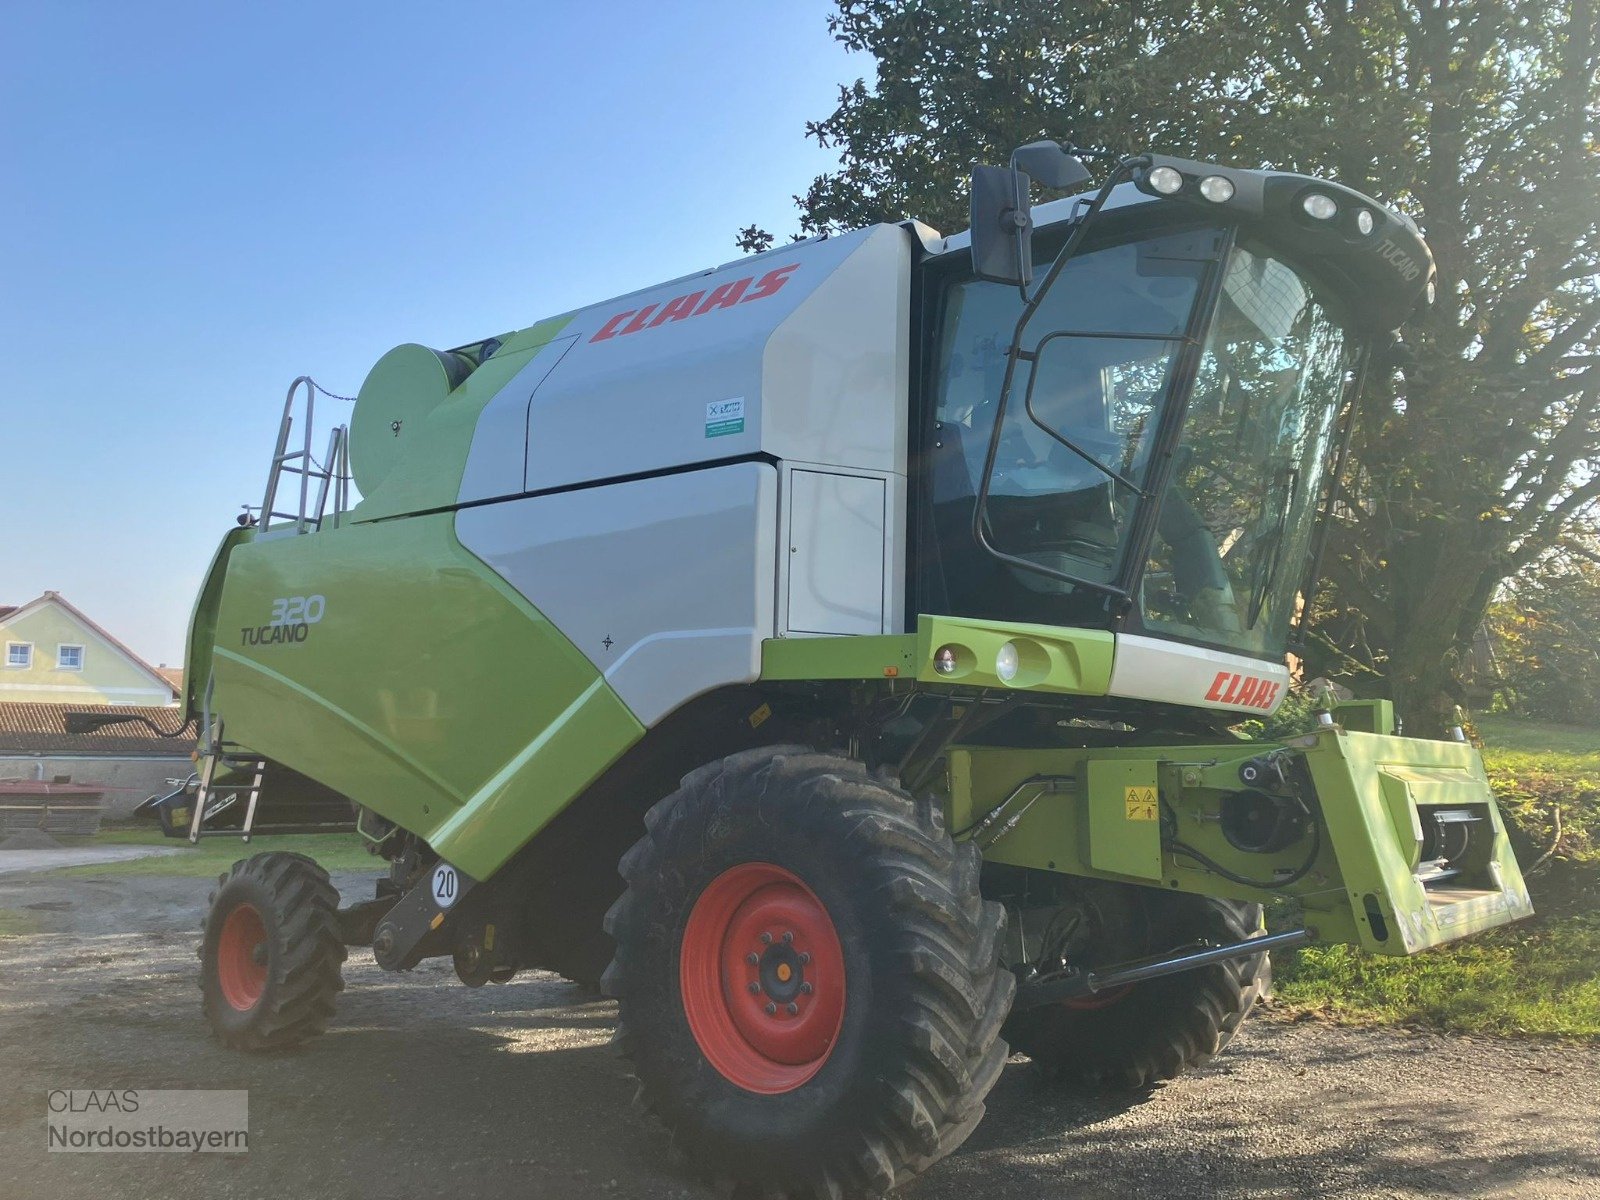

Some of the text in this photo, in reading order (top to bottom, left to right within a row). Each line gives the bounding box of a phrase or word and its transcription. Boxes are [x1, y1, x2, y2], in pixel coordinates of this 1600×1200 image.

[1376, 239, 1420, 282] TUCANO
[588, 263, 801, 343] CLAAS
[270, 594, 326, 627] 320
[241, 622, 309, 646] TUCANO
[1204, 671, 1281, 709] CLAAS
[437, 869, 455, 898] 20
